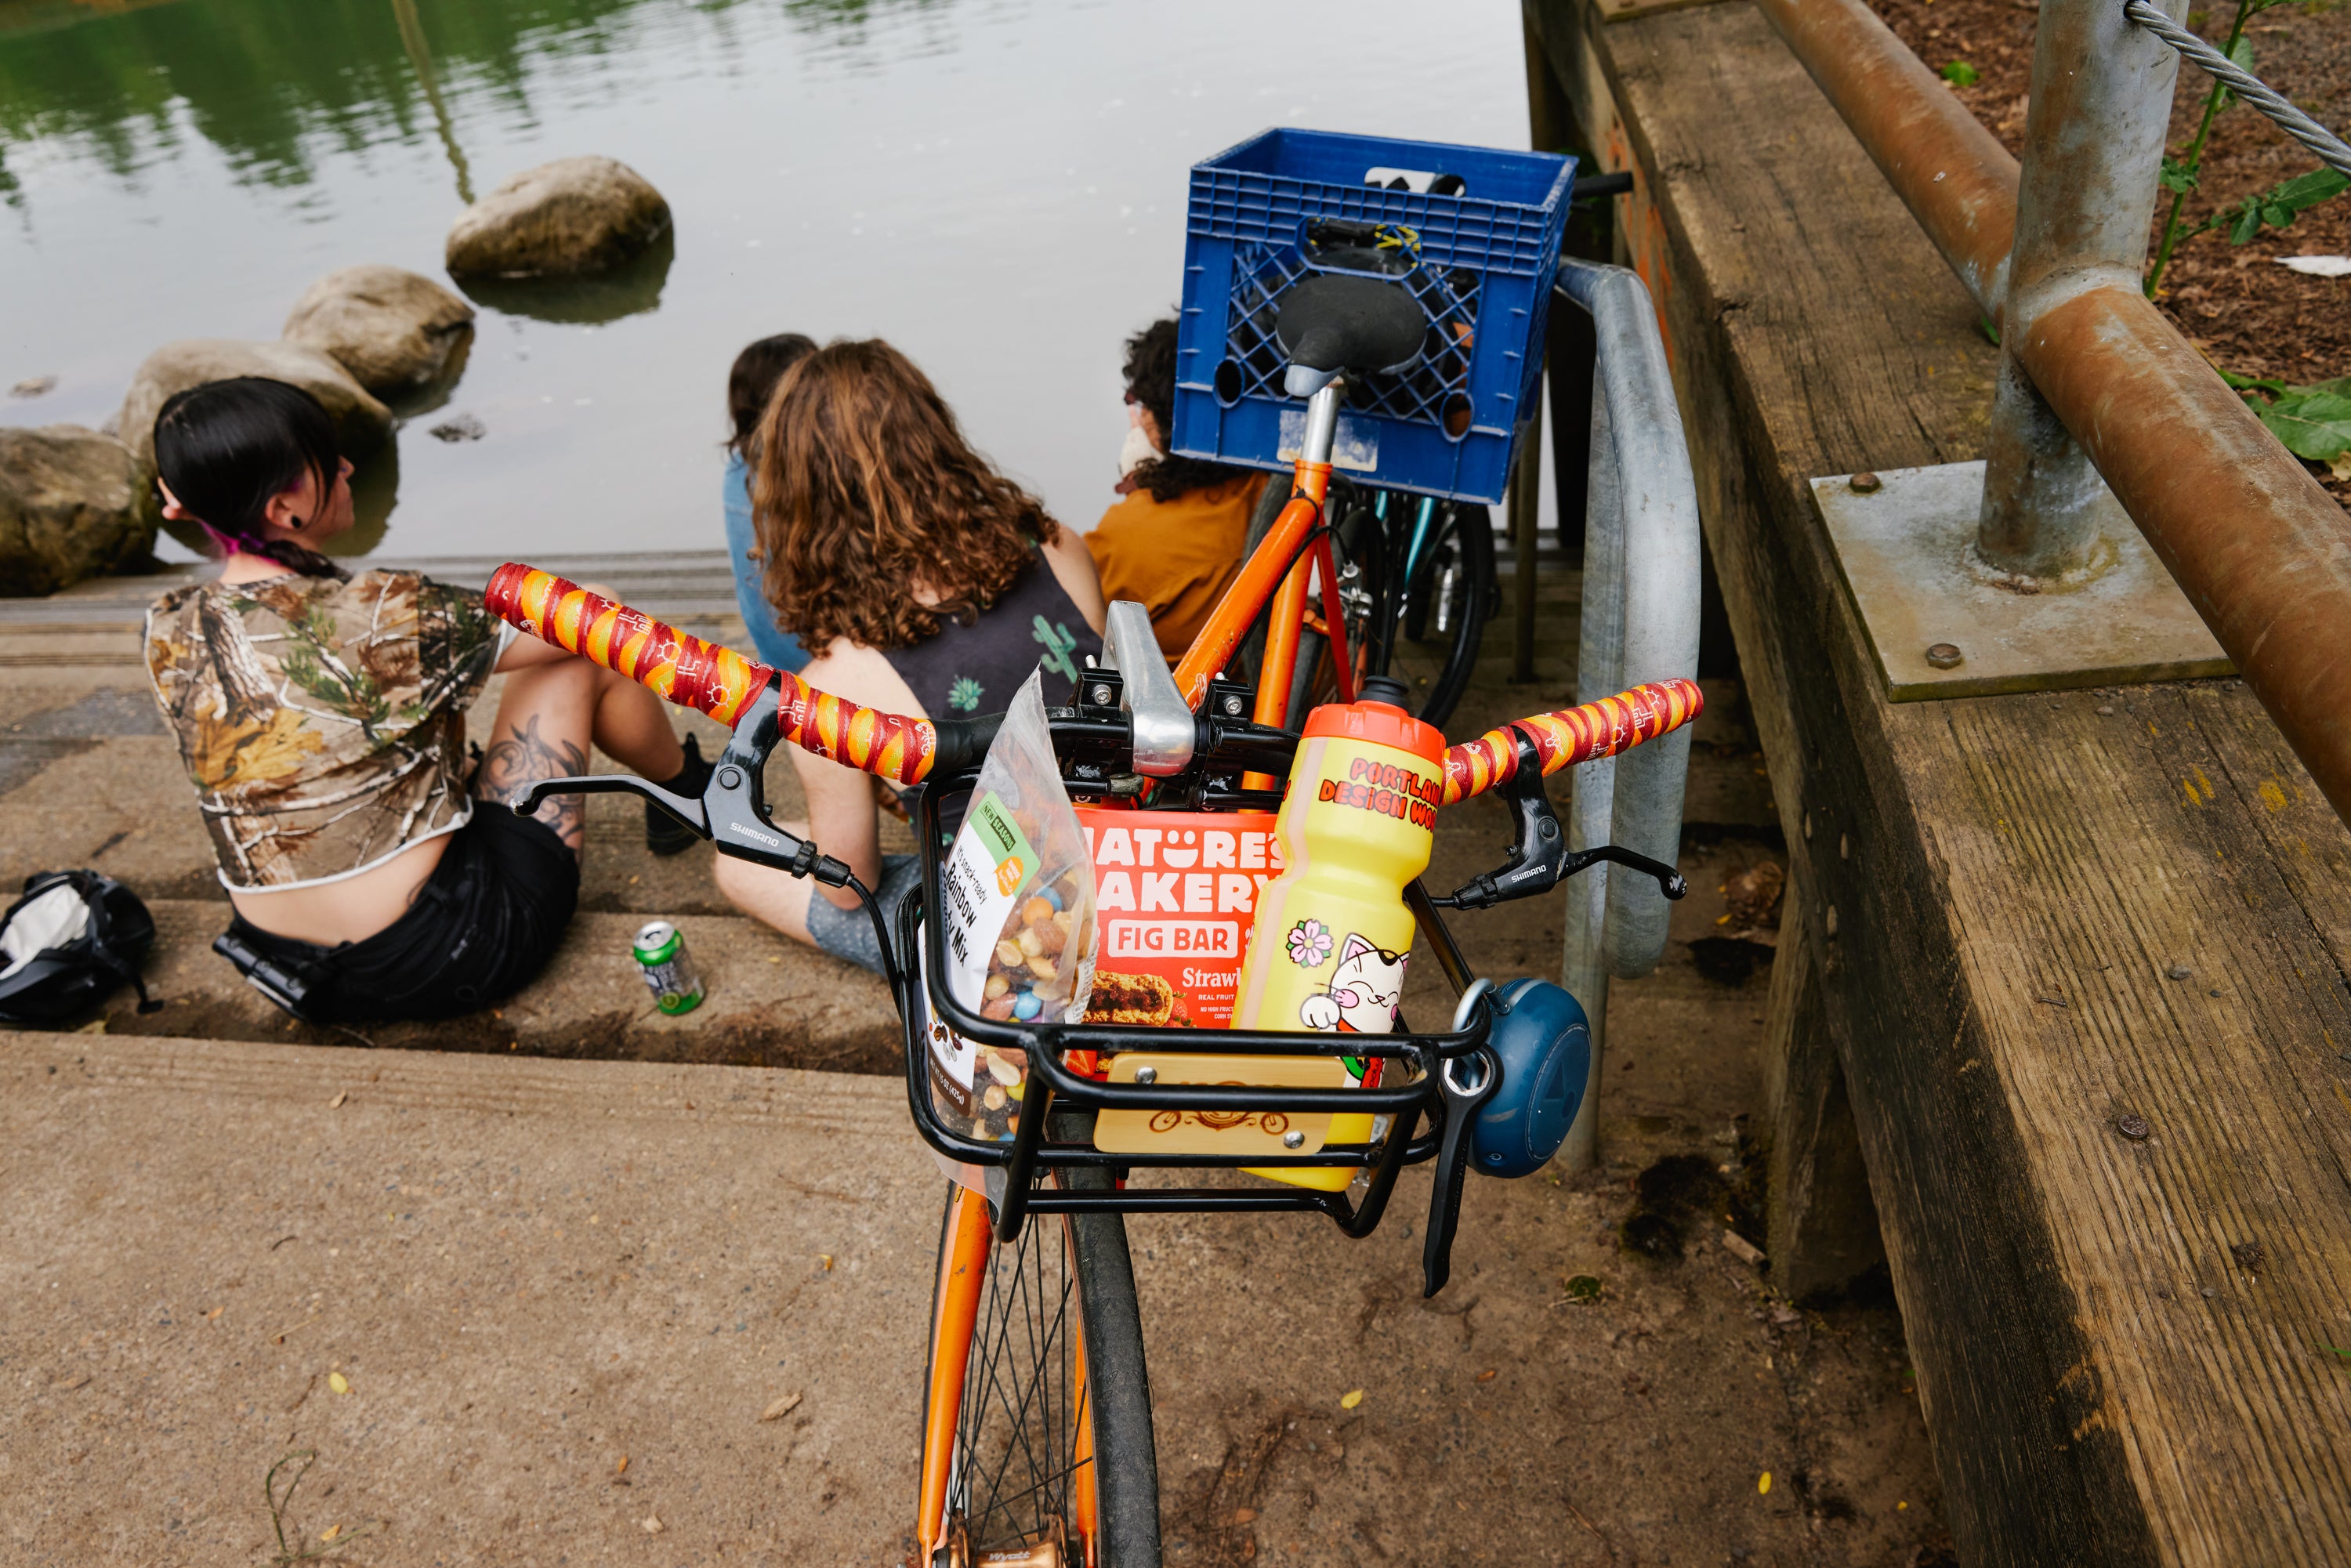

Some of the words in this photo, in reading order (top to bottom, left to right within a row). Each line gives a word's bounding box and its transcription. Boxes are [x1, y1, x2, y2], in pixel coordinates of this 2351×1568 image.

[730, 822, 779, 847] SHIMANO
[982, 804, 995, 821] NEW
[992, 817, 1014, 849] SEASONS
[962, 858, 987, 905] snack-ready
[1511, 864, 1547, 883] SHIMANO
[946, 861, 977, 929] Rainbow
[951, 926, 969, 968] Mix
[1118, 927, 1163, 951] FIG
[1174, 928, 1228, 951] BAR
[943, 1078, 949, 1091] OZ
[949, 1085, 965, 1106] (425g)
